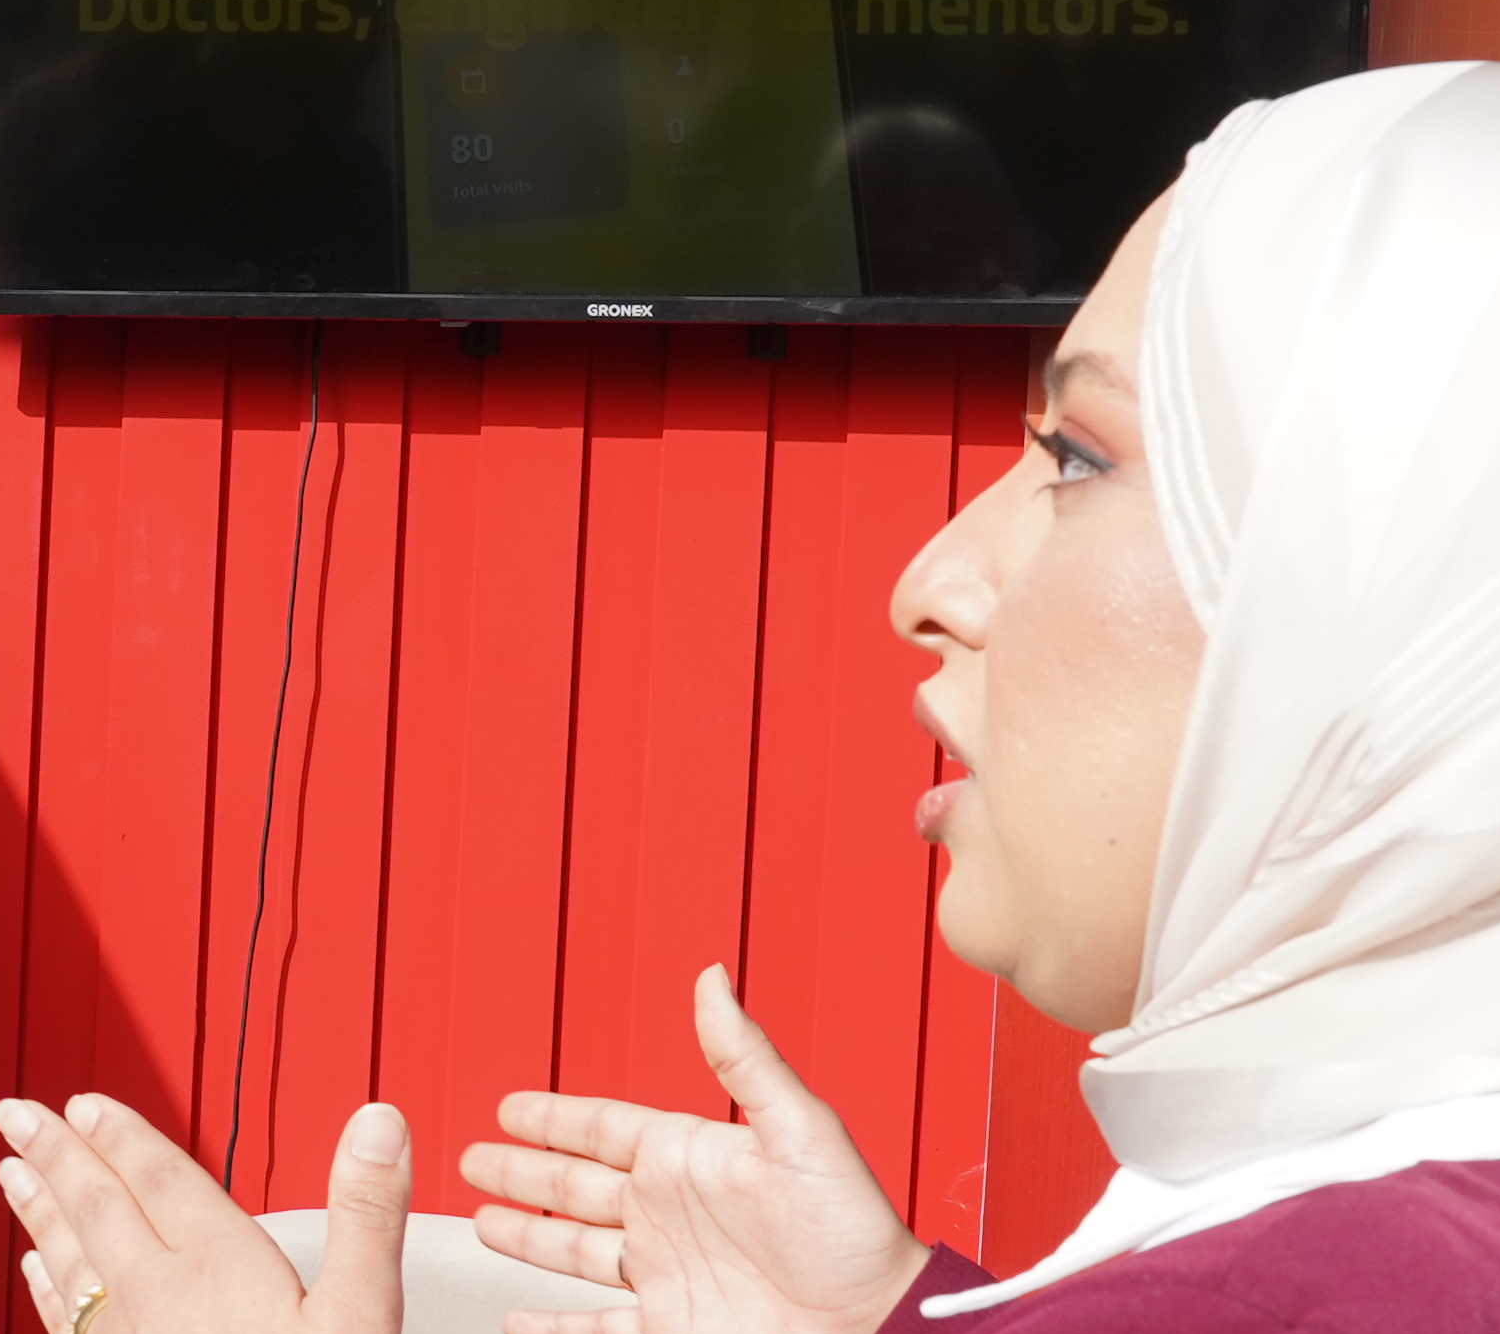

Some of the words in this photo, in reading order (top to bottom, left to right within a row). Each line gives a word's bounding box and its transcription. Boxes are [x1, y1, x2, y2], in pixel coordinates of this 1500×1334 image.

[451, 133, 494, 165] 80
[452, 184, 488, 200] Total
[492, 180, 532, 197] Visits
[586, 303, 653, 317] GRONEX
